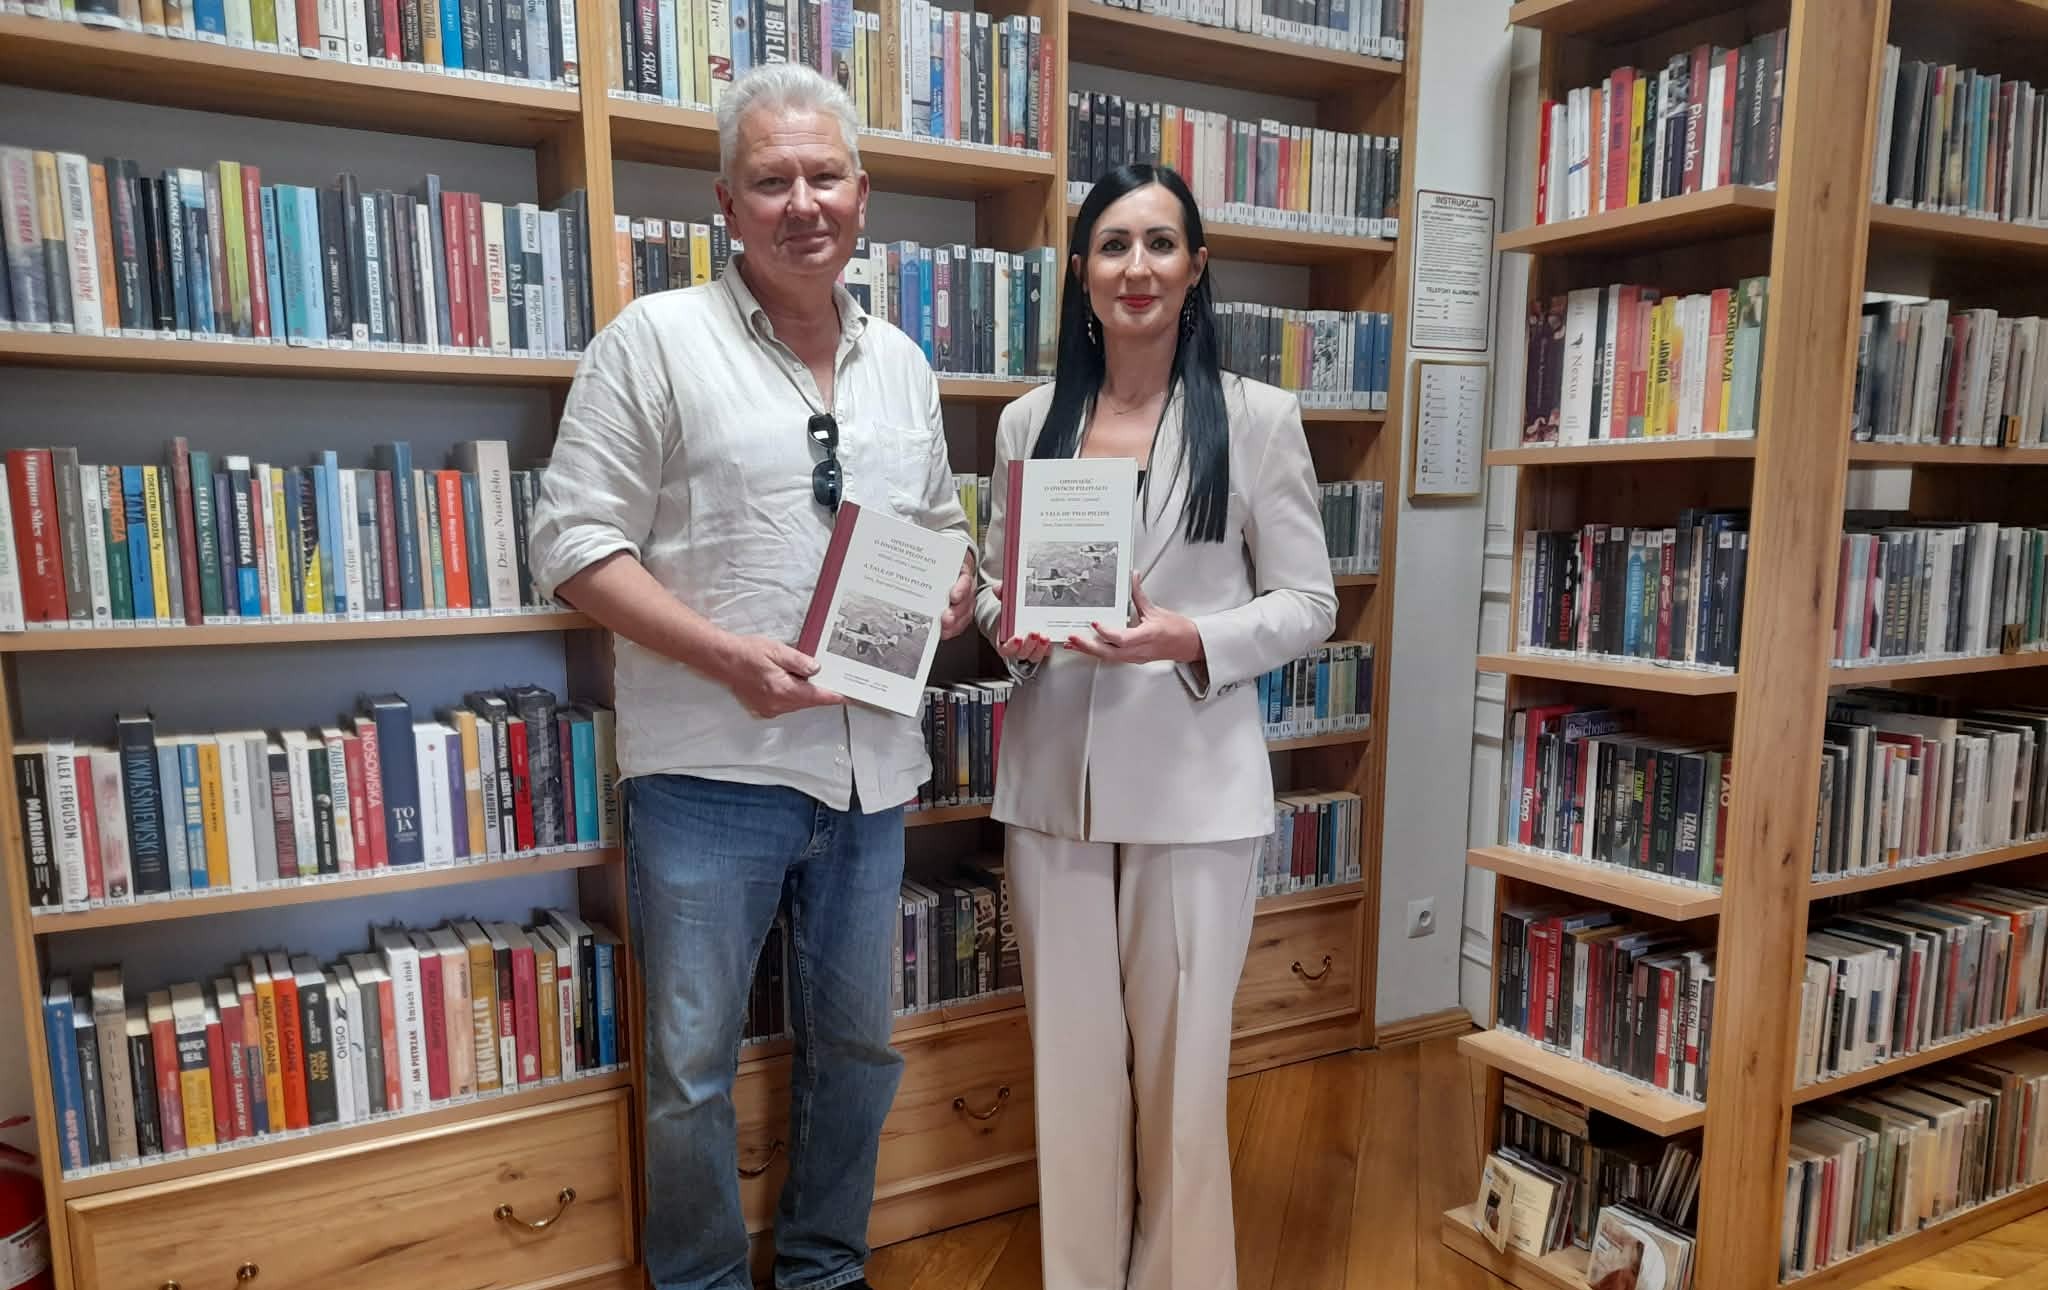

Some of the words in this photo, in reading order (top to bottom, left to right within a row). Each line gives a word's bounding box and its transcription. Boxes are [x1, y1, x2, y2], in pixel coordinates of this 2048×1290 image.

[765, 19, 785, 66] BIELA
[1435, 196, 1480, 209] INSTRUKCJA
[487, 243, 502, 294] HITLERA
[235, 492, 252, 565] REPORTERKA
[56, 756, 73, 780] ALEX
[361, 730, 381, 808] NOSOWSKA
[60, 784, 79, 841] FERGUSON
[127, 758, 159, 856] KWAŚNIEWSKI
[1520, 787, 1534, 822] Klopp
[26, 798, 48, 867] MARINES
[1682, 811, 1698, 852] IZRAEL
[1686, 979, 1699, 1029] TERLECKI
[335, 1025, 348, 1060] OSHO
